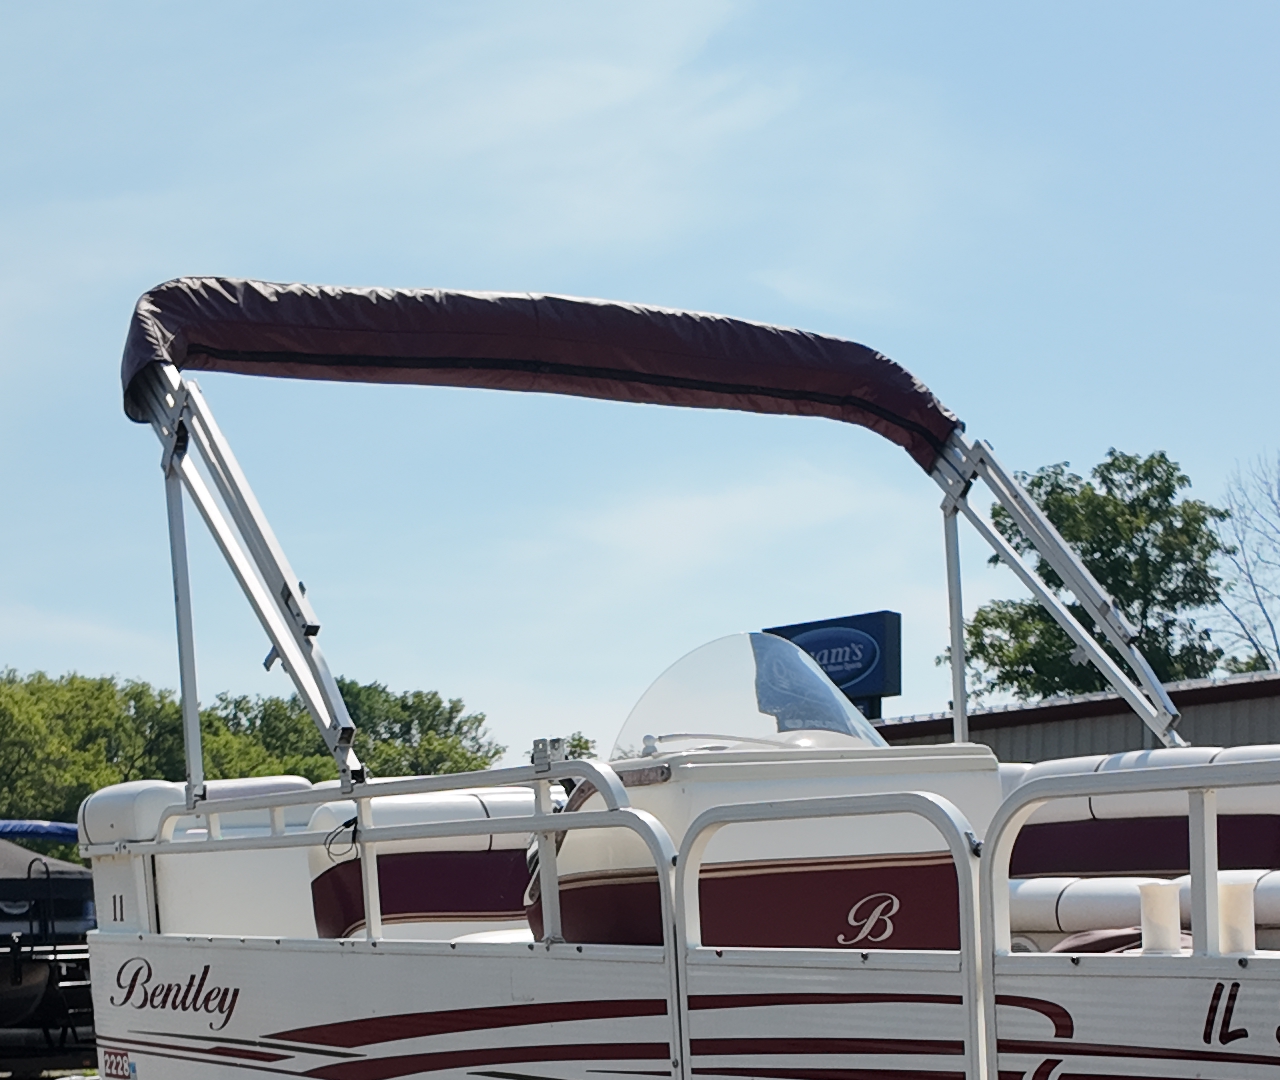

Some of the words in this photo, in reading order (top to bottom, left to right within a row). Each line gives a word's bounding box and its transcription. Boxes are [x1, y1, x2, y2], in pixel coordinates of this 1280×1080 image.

[836, 892, 900, 945] B
[109, 956, 240, 1031] Bentley
[1203, 982, 1249, 1045] IL
[104, 1053, 130, 1077] 2228
